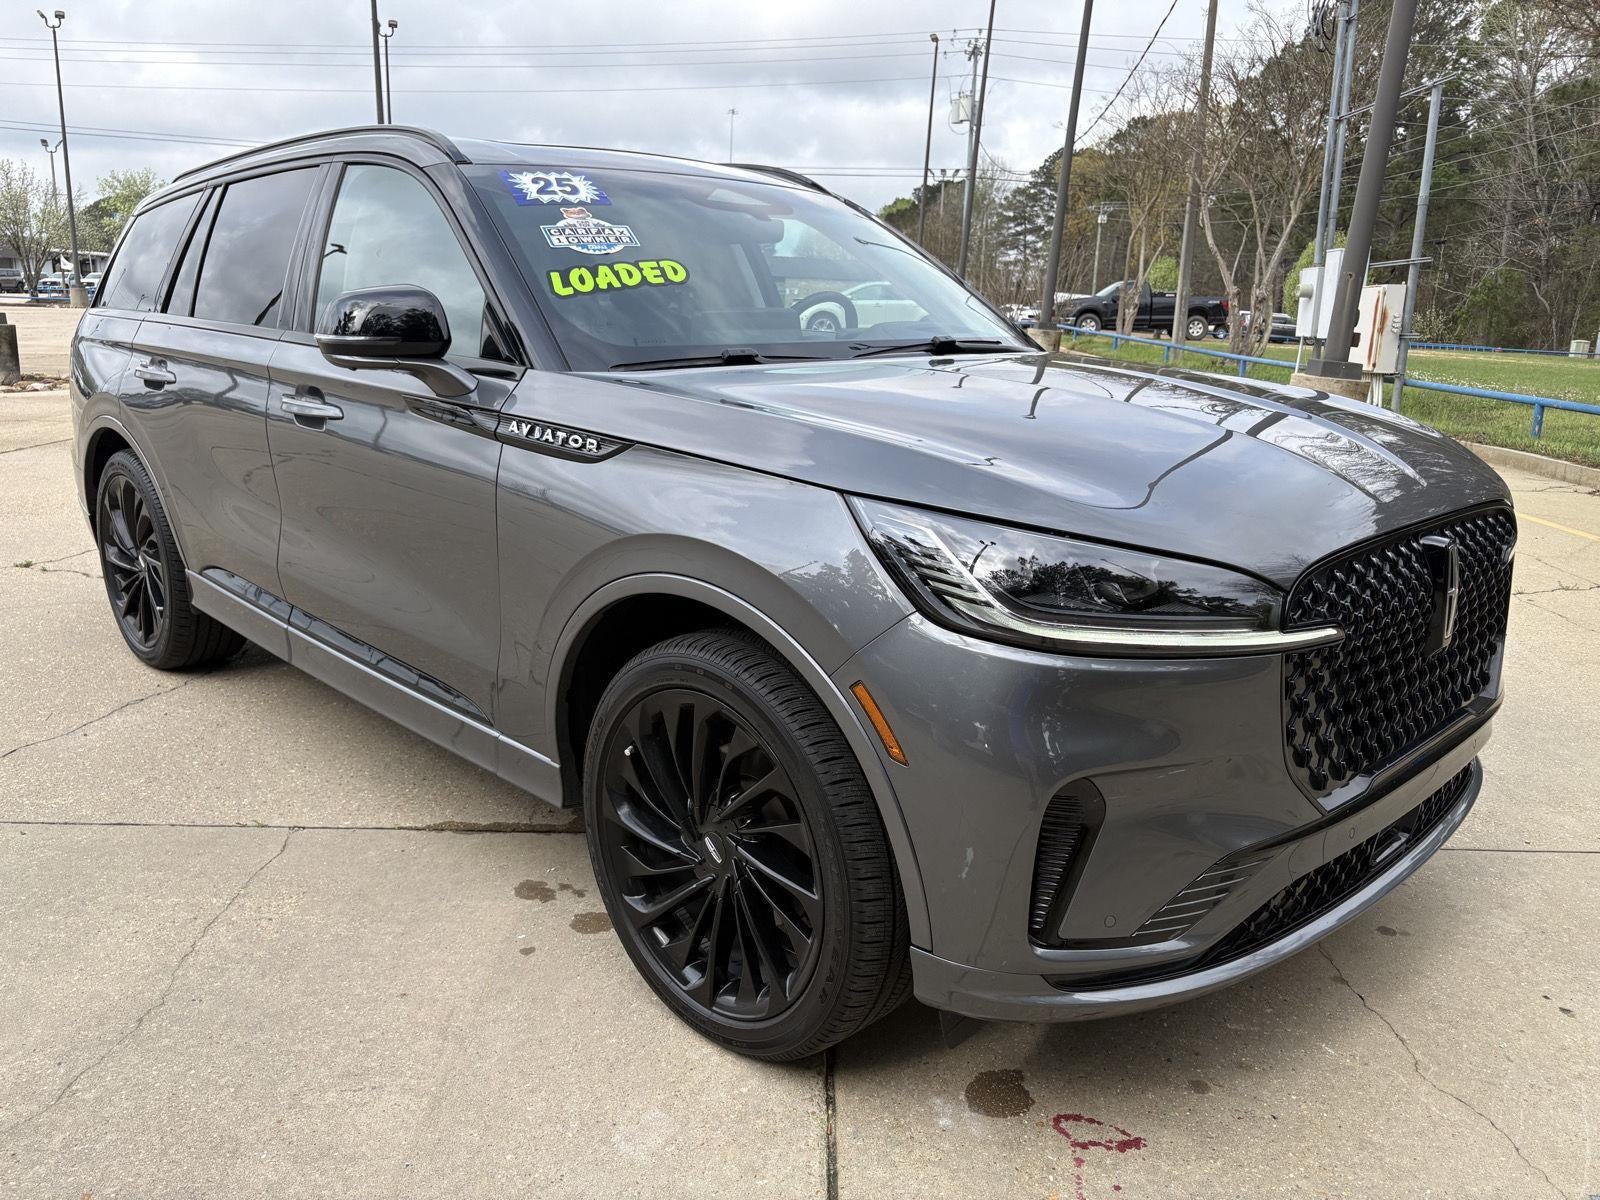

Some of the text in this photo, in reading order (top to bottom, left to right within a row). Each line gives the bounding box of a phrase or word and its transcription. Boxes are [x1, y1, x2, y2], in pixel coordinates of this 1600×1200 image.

[530, 176, 581, 196] 25
[549, 227, 630, 236] CARFAX
[567, 236, 633, 244] OWNER
[549, 259, 687, 297] LOADED
[508, 420, 598, 453] AVIATOR
